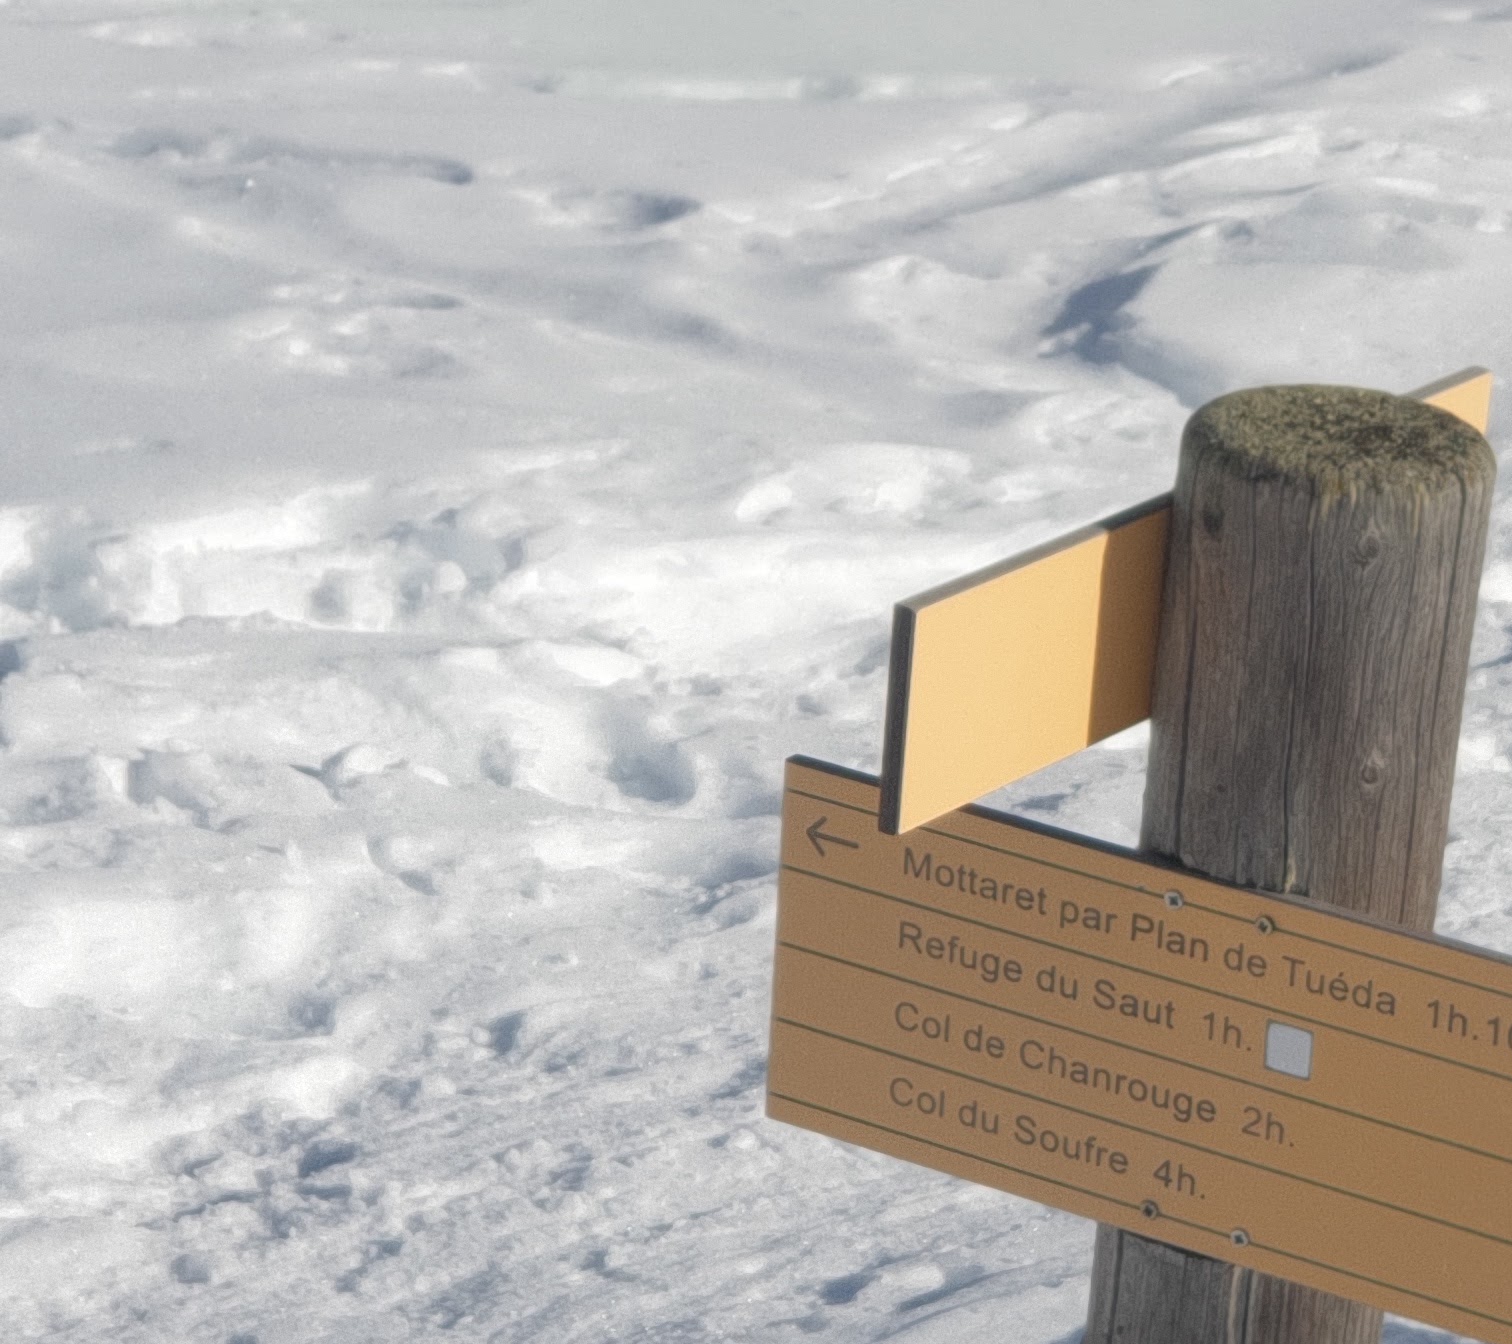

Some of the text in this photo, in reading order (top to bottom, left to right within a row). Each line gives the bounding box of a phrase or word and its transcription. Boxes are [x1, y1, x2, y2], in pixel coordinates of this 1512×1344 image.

[898, 920, 1253, 1053] Refuge du Saut 1h.
[903, 846, 1047, 916] Mottaret
[1059, 900, 1118, 935] par
[1130, 912, 1209, 963] Plan
[1223, 943, 1268, 979] de
[1281, 955, 1397, 1017] Tuéda
[889, 1077, 1207, 1200] Col du Soufre 4h.
[894, 1001, 1296, 1148] Col de Chanrouge 2h.
